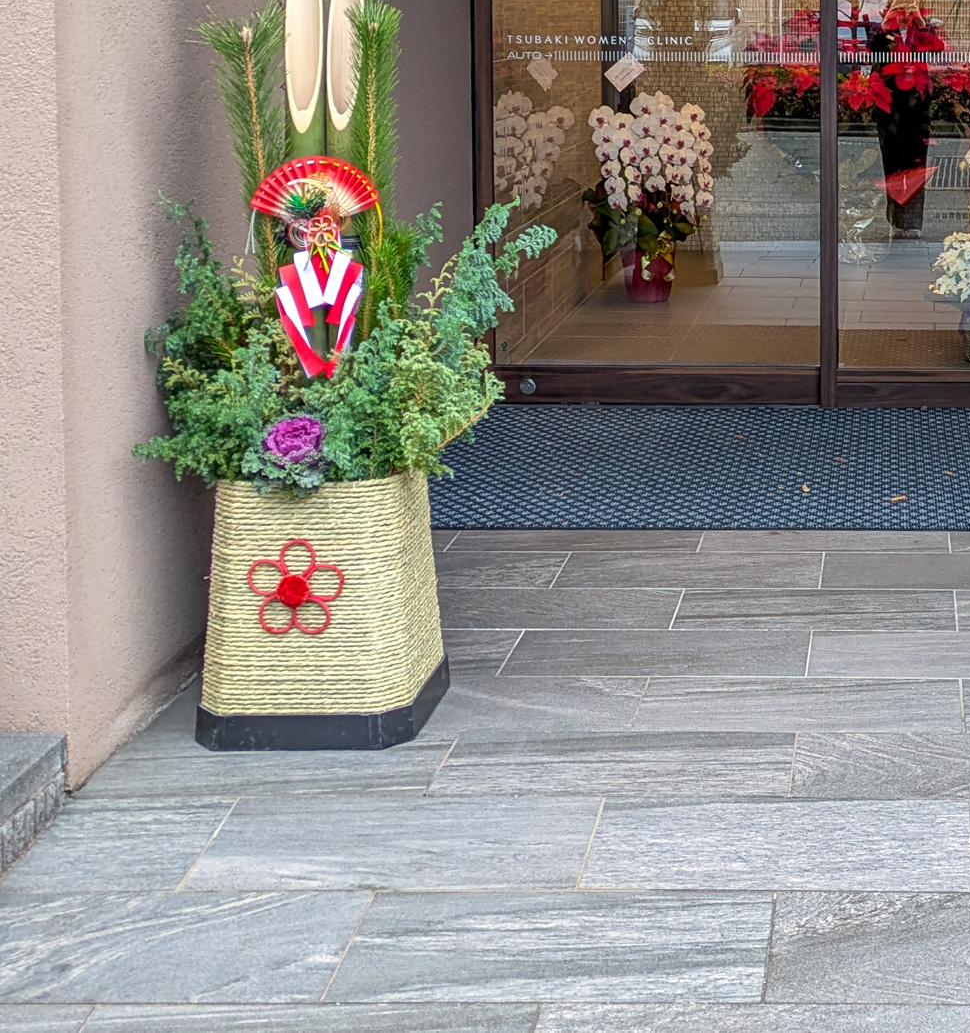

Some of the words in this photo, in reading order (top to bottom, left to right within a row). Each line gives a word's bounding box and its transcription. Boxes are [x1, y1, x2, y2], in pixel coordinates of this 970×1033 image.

[507, 35, 569, 44] TSUBAKI
[574, 35, 641, 45] WOMEN'S
[647, 36, 693, 46] CLINIC
[506, 51, 542, 60] AUTO
